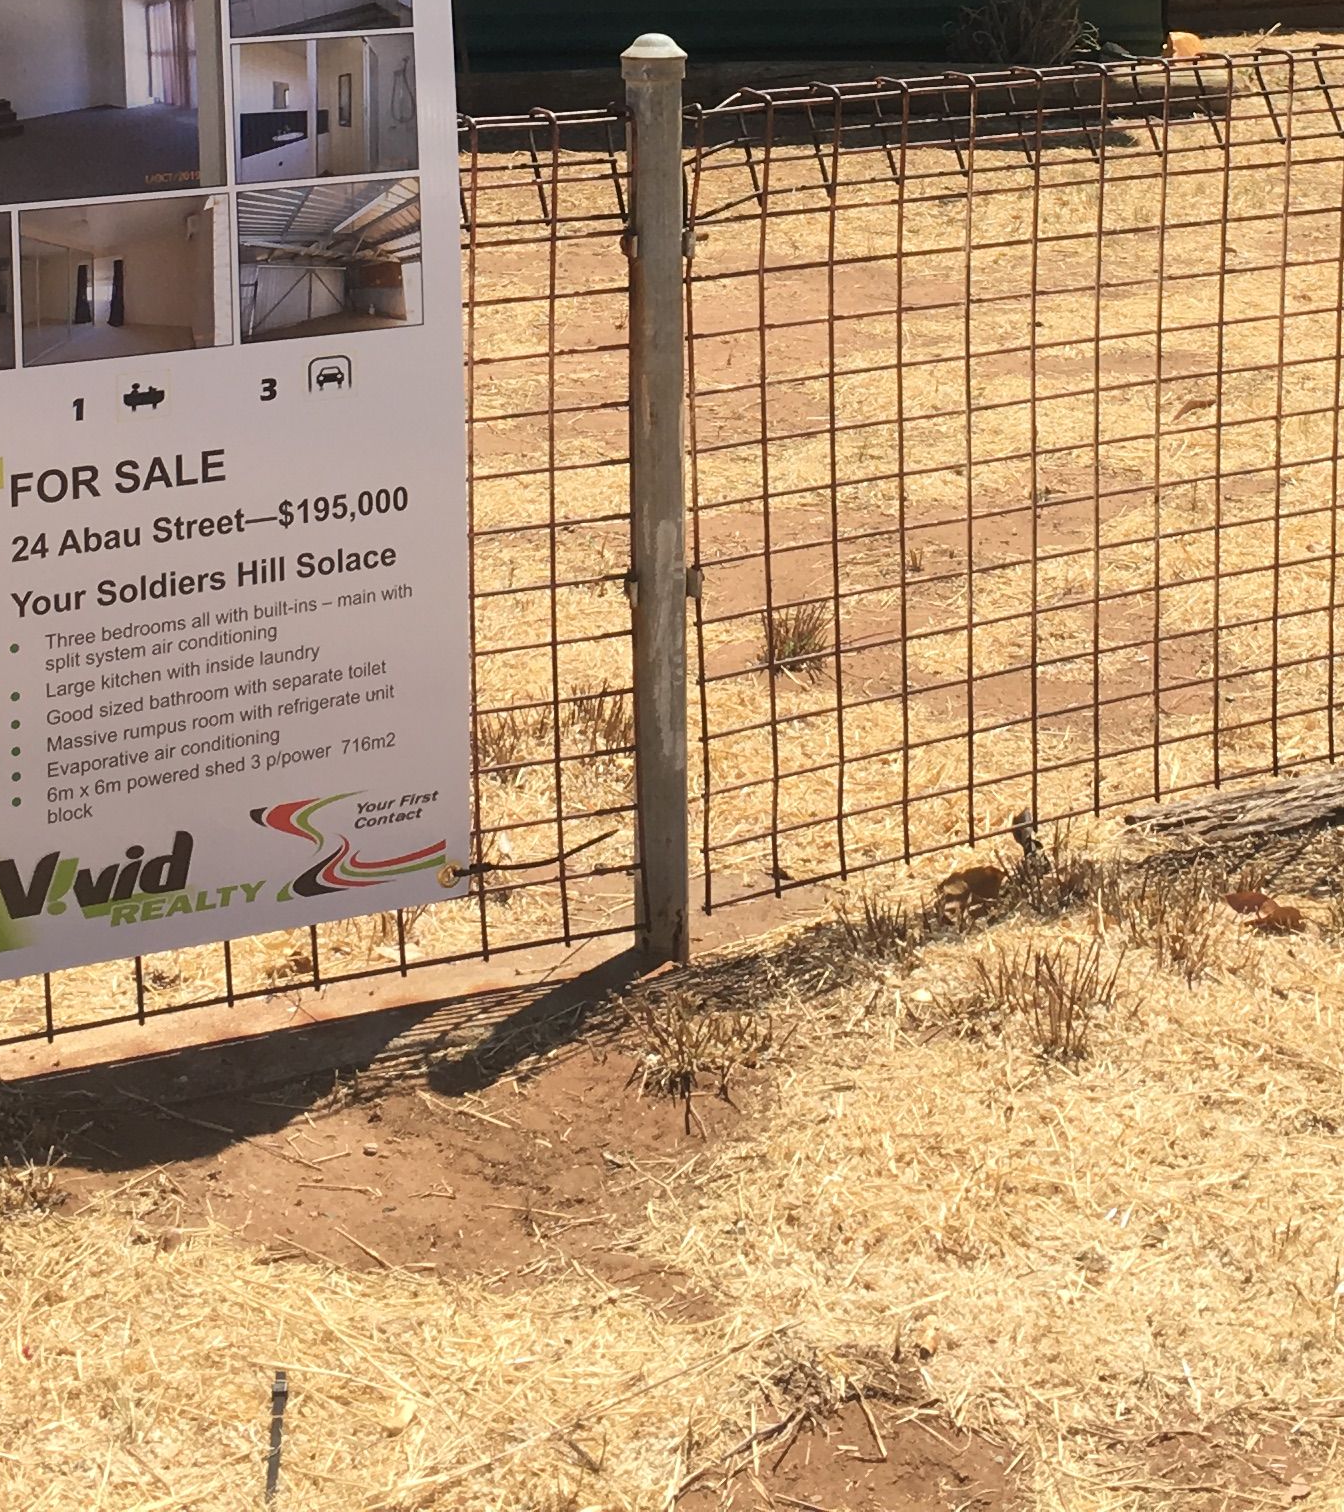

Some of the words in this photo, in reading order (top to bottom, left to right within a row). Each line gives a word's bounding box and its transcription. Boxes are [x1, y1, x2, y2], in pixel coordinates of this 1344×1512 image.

[72, 397, 85, 422] 1
[259, 378, 278, 402] 3
[10, 465, 101, 508] FOR
[114, 448, 226, 494] SALE
[11, 533, 49, 563] 24
[58, 526, 141, 557] Abau
[10, 588, 87, 618] Your
[96, 571, 226, 607] Soldiers
[237, 556, 285, 587] Hill
[296, 547, 397, 579] Solace
[45, 631, 96, 650] Three
[101, 617, 186, 642] bedrooms
[191, 611, 210, 628] all
[215, 607, 249, 625] with
[254, 598, 317, 620] built-ins
[337, 589, 376, 608] main
[381, 583, 413, 601] with
[45, 652, 80, 673] split
[85, 645, 146, 668] system
[151, 638, 173, 656] air
[178, 625, 278, 652] conditioning
[46, 679, 95, 698] Large
[101, 669, 162, 690] kitchen
[167, 661, 200, 680] with
[206, 654, 255, 674] inside
[259, 645, 320, 666] laundry
[46, 704, 94, 726] Good
[99, 697, 144, 718] sized
[149, 686, 229, 710] bathroom
[234, 677, 267, 696] with
[272, 668, 343, 691] separate
[348, 660, 387, 679] toilet
[47, 729, 118, 752] Massive
[123, 719, 186, 740] rumpus
[192, 711, 235, 730] room
[239, 704, 273, 722] with
[277, 692, 360, 716] refrigerate
[365, 684, 395, 702] unit
[47, 749, 149, 778] Evaporative
[154, 743, 176, 762] air
[181, 729, 280, 757] conditioning
[47, 787, 74, 803] 6m
[79, 786, 90, 798] x
[95, 779, 121, 796] 6m
[127, 764, 200, 793] powered
[205, 757, 245, 777] shed
[251, 754, 261, 770] 3
[266, 744, 332, 770] p/power
[342, 732, 396, 755] 716m2
[47, 803, 93, 824] block
[354, 807, 423, 830] Contact
[356, 798, 396, 815] Your
[399, 790, 439, 808] First
[110, 881, 267, 928] REALTY
